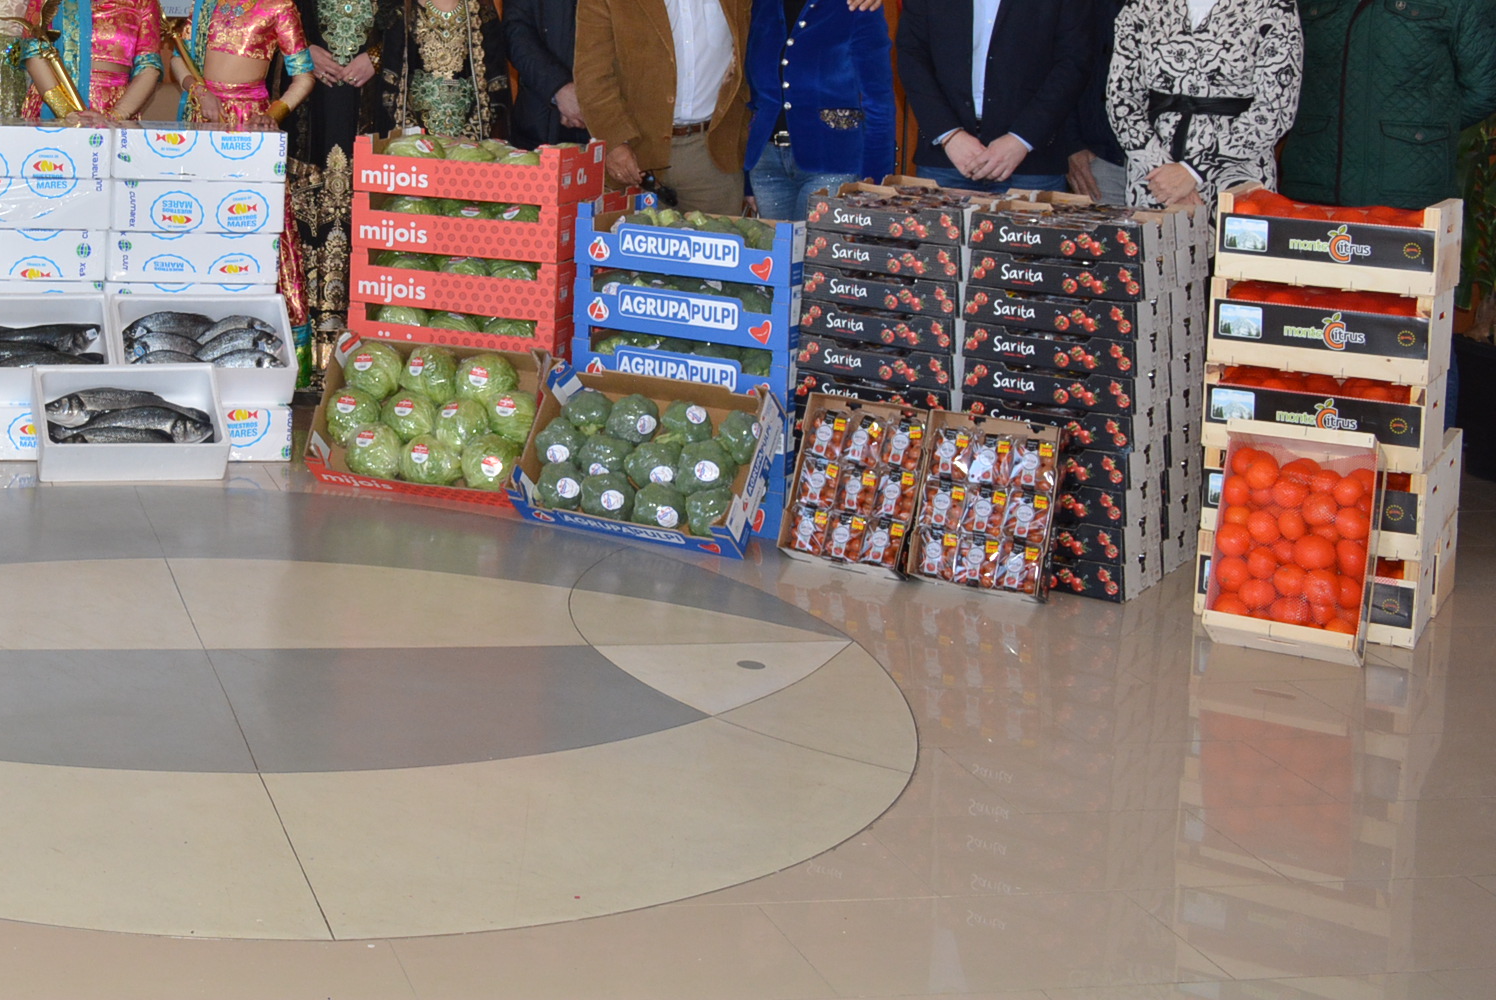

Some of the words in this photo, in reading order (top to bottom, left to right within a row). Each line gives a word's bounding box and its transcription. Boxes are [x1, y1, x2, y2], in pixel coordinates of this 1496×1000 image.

[220, 142, 252, 150] MARES
[36, 180, 67, 189] MARES
[361, 163, 429, 192] mijois
[162, 199, 193, 208] MARES
[226, 220, 257, 228] MARES
[833, 208, 872, 226] Sarita
[359, 219, 428, 247] mijois
[999, 226, 1042, 244] Sarita
[622, 233, 737, 263] AGRUPAPULPI
[831, 243, 870, 261] Sarita
[1000, 263, 1043, 282] Sarita
[358, 275, 426, 302] mijois
[829, 279, 867, 297] Sarita
[620, 294, 736, 326] AGRUPAPULPI
[993, 299, 1036, 318] Sarita
[826, 312, 864, 332] Sarita
[993, 335, 1035, 355] Sarita
[823, 349, 862, 368] Sarita
[993, 372, 1035, 391] Sarita
[321, 472, 393, 491] mijois
[564, 514, 683, 543] AGRUPAPULPI
